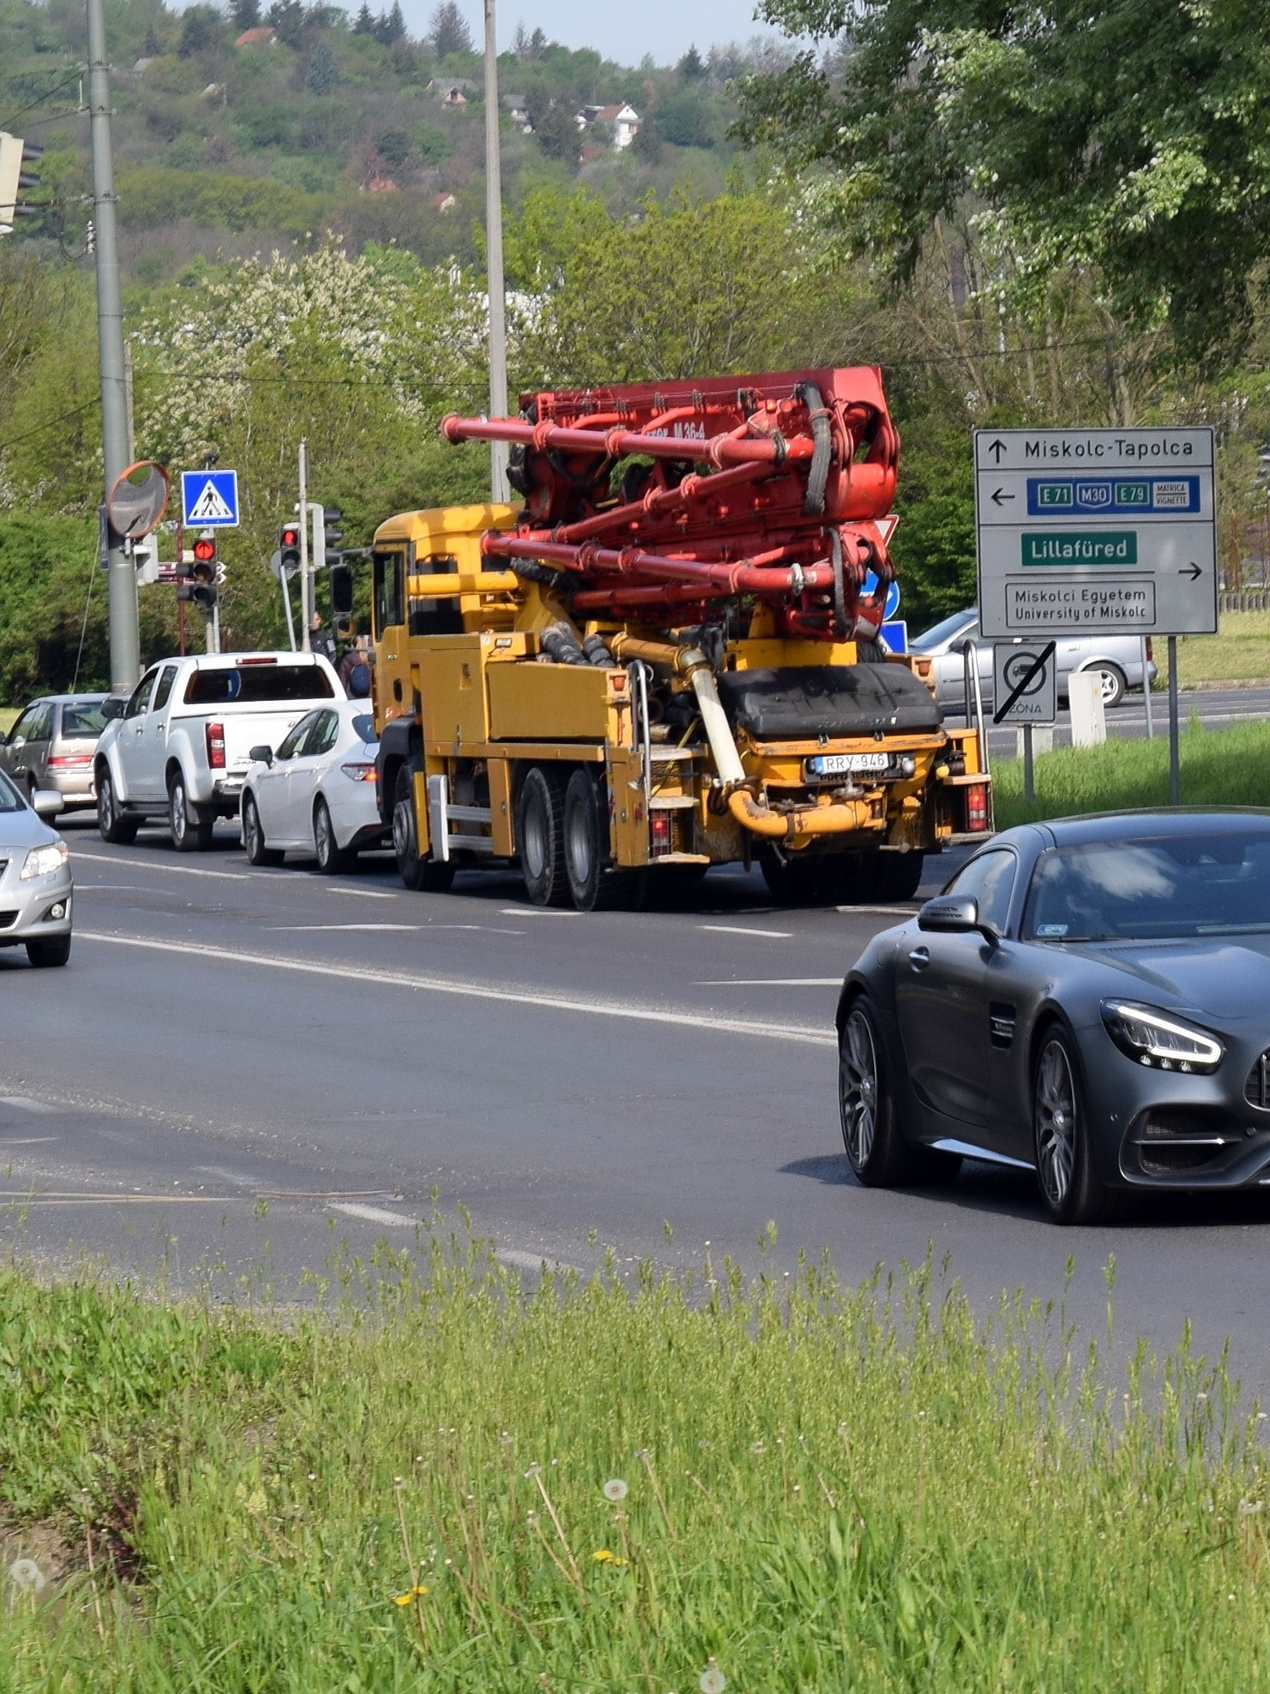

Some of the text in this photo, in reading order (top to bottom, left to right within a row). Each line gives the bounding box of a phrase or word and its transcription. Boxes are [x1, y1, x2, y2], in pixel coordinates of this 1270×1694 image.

[1025, 438, 1193, 460] Miskolc-Tapolca
[1043, 488, 1068, 502] E 71
[1081, 487, 1106, 501] M30
[1121, 487, 1144, 500] E 79
[1157, 484, 1186, 493] MATRICA
[1156, 495, 1187, 505] VIGNETTE
[1031, 540, 1127, 559] Lillafüred
[1015, 588, 1146, 604] Miskolci Egyetem
[1015, 605, 1146, 621] University of Miskolc
[826, 753, 885, 770] RRY-946
